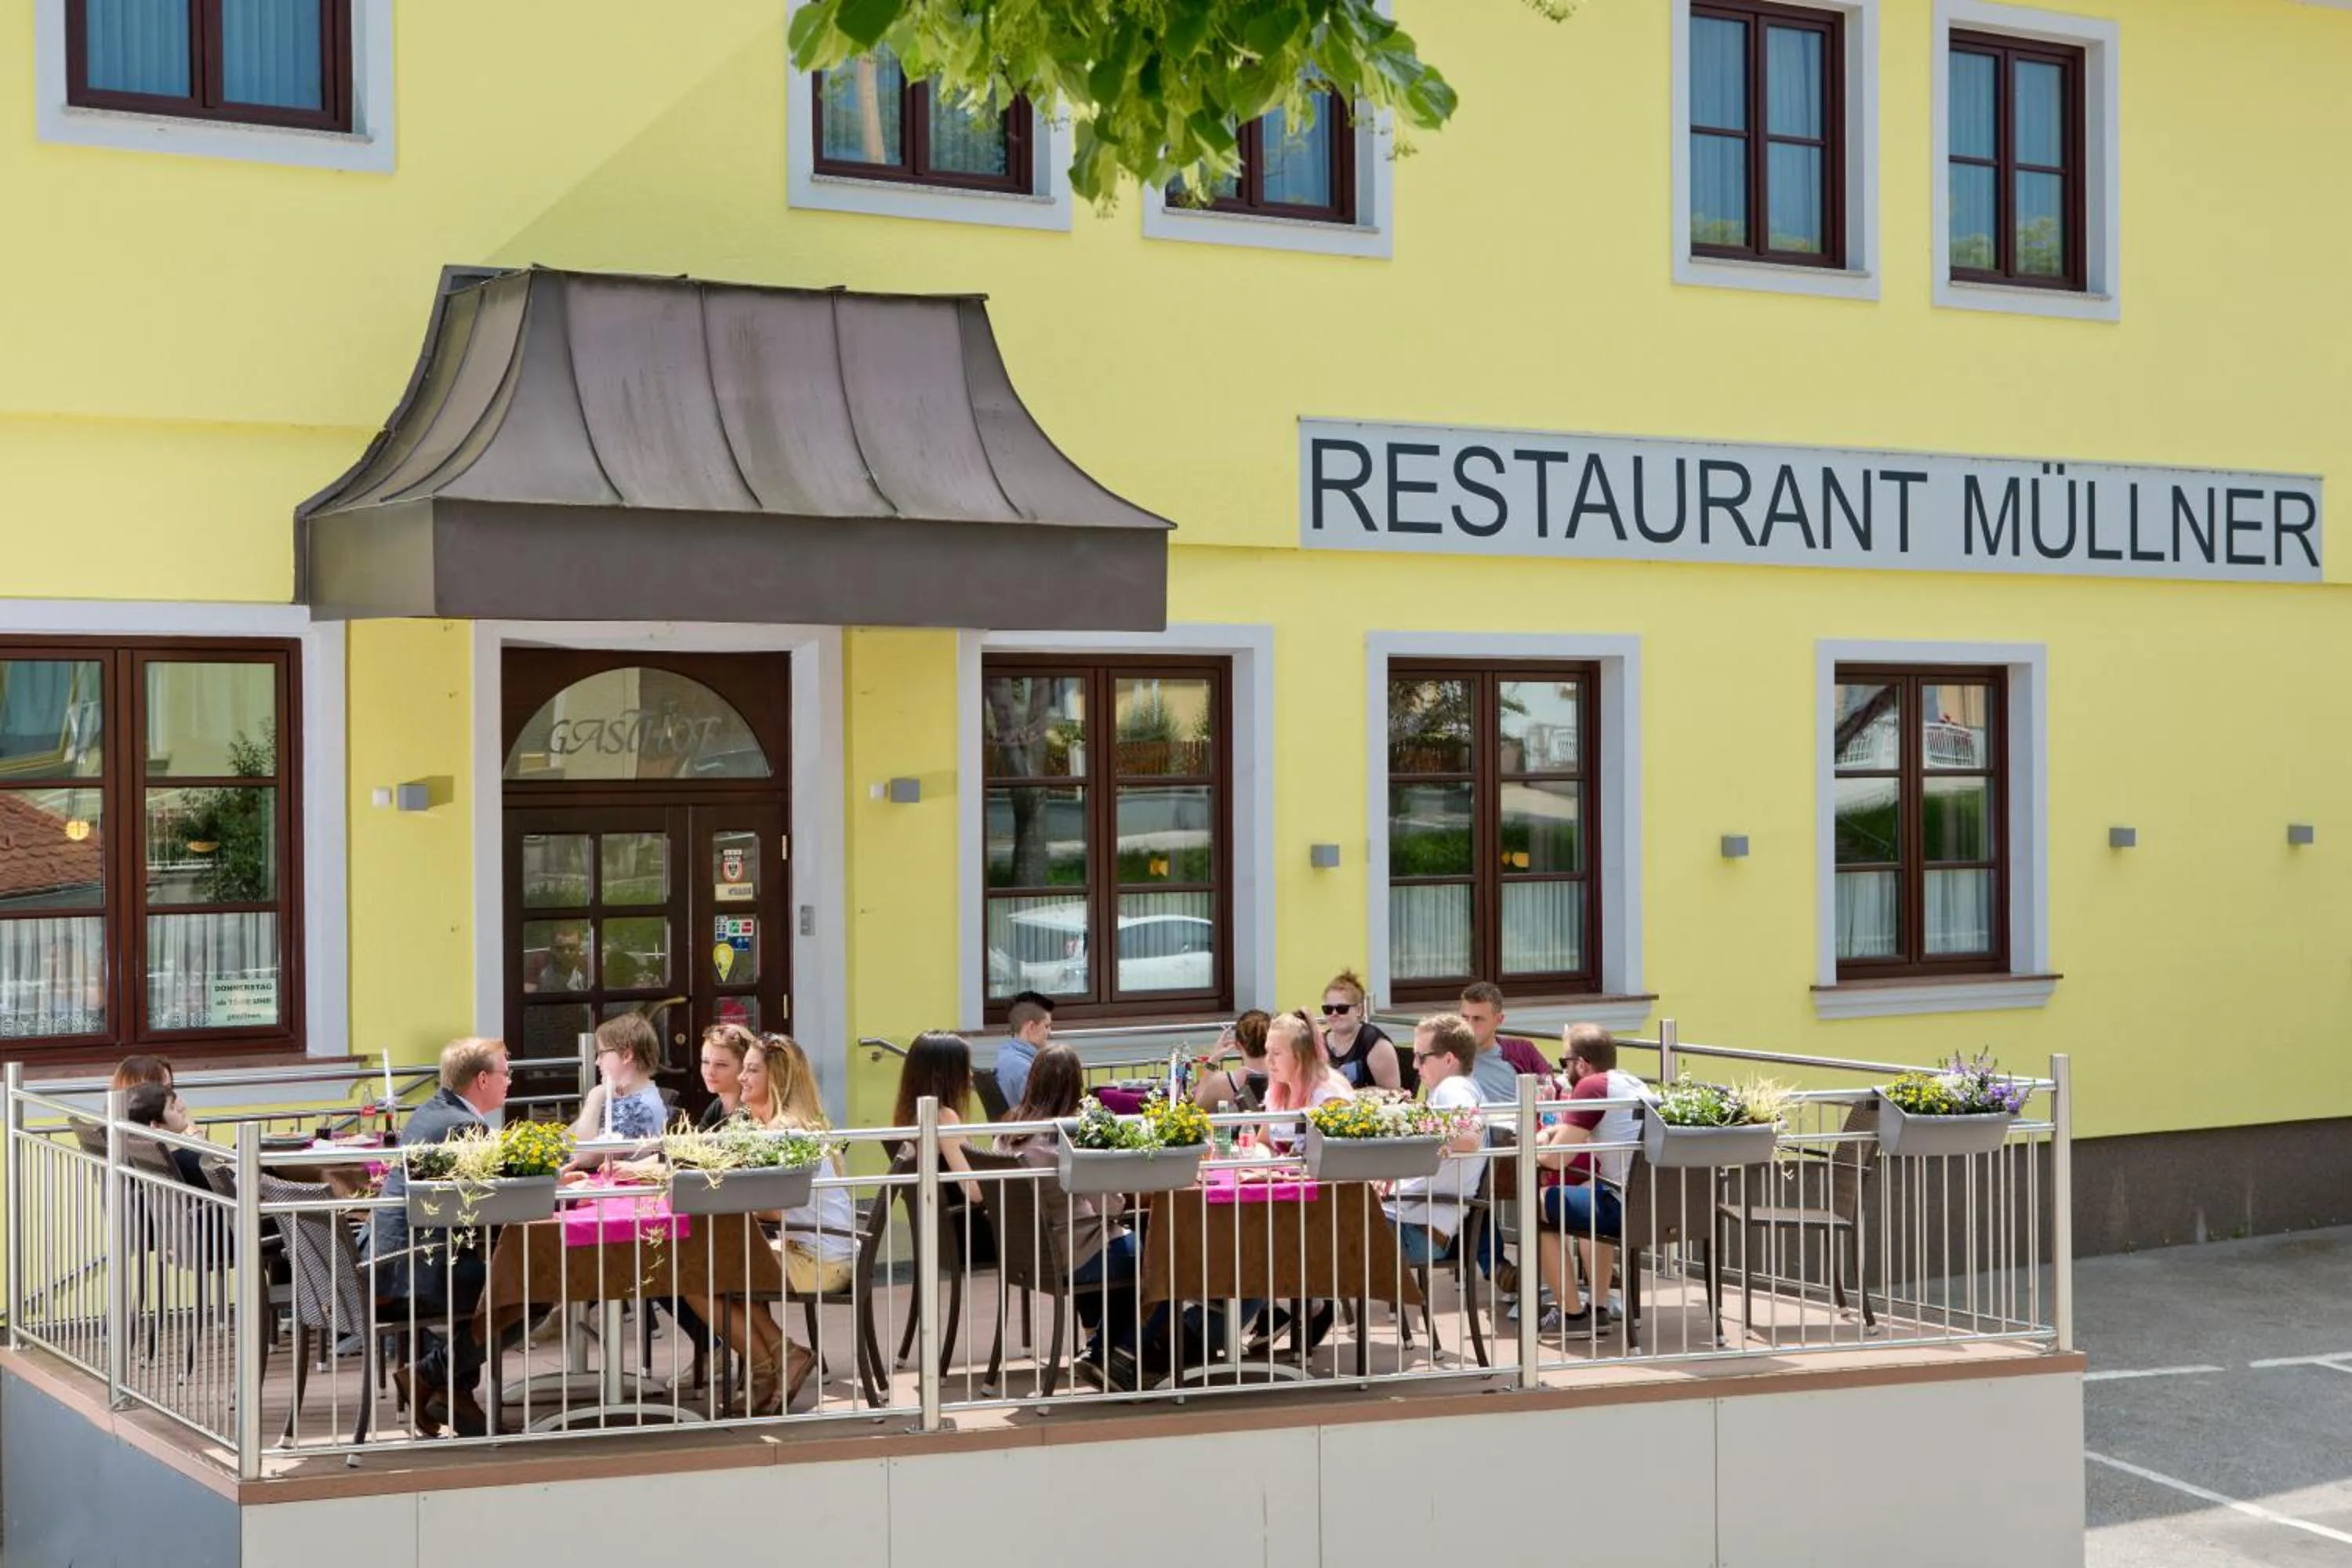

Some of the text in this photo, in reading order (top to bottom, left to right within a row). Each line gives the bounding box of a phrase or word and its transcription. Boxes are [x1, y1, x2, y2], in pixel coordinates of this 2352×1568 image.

[1311, 437, 2321, 568] RESTAURANT MÜLLNER
[214, 983, 272, 992] DONNERSTAG
